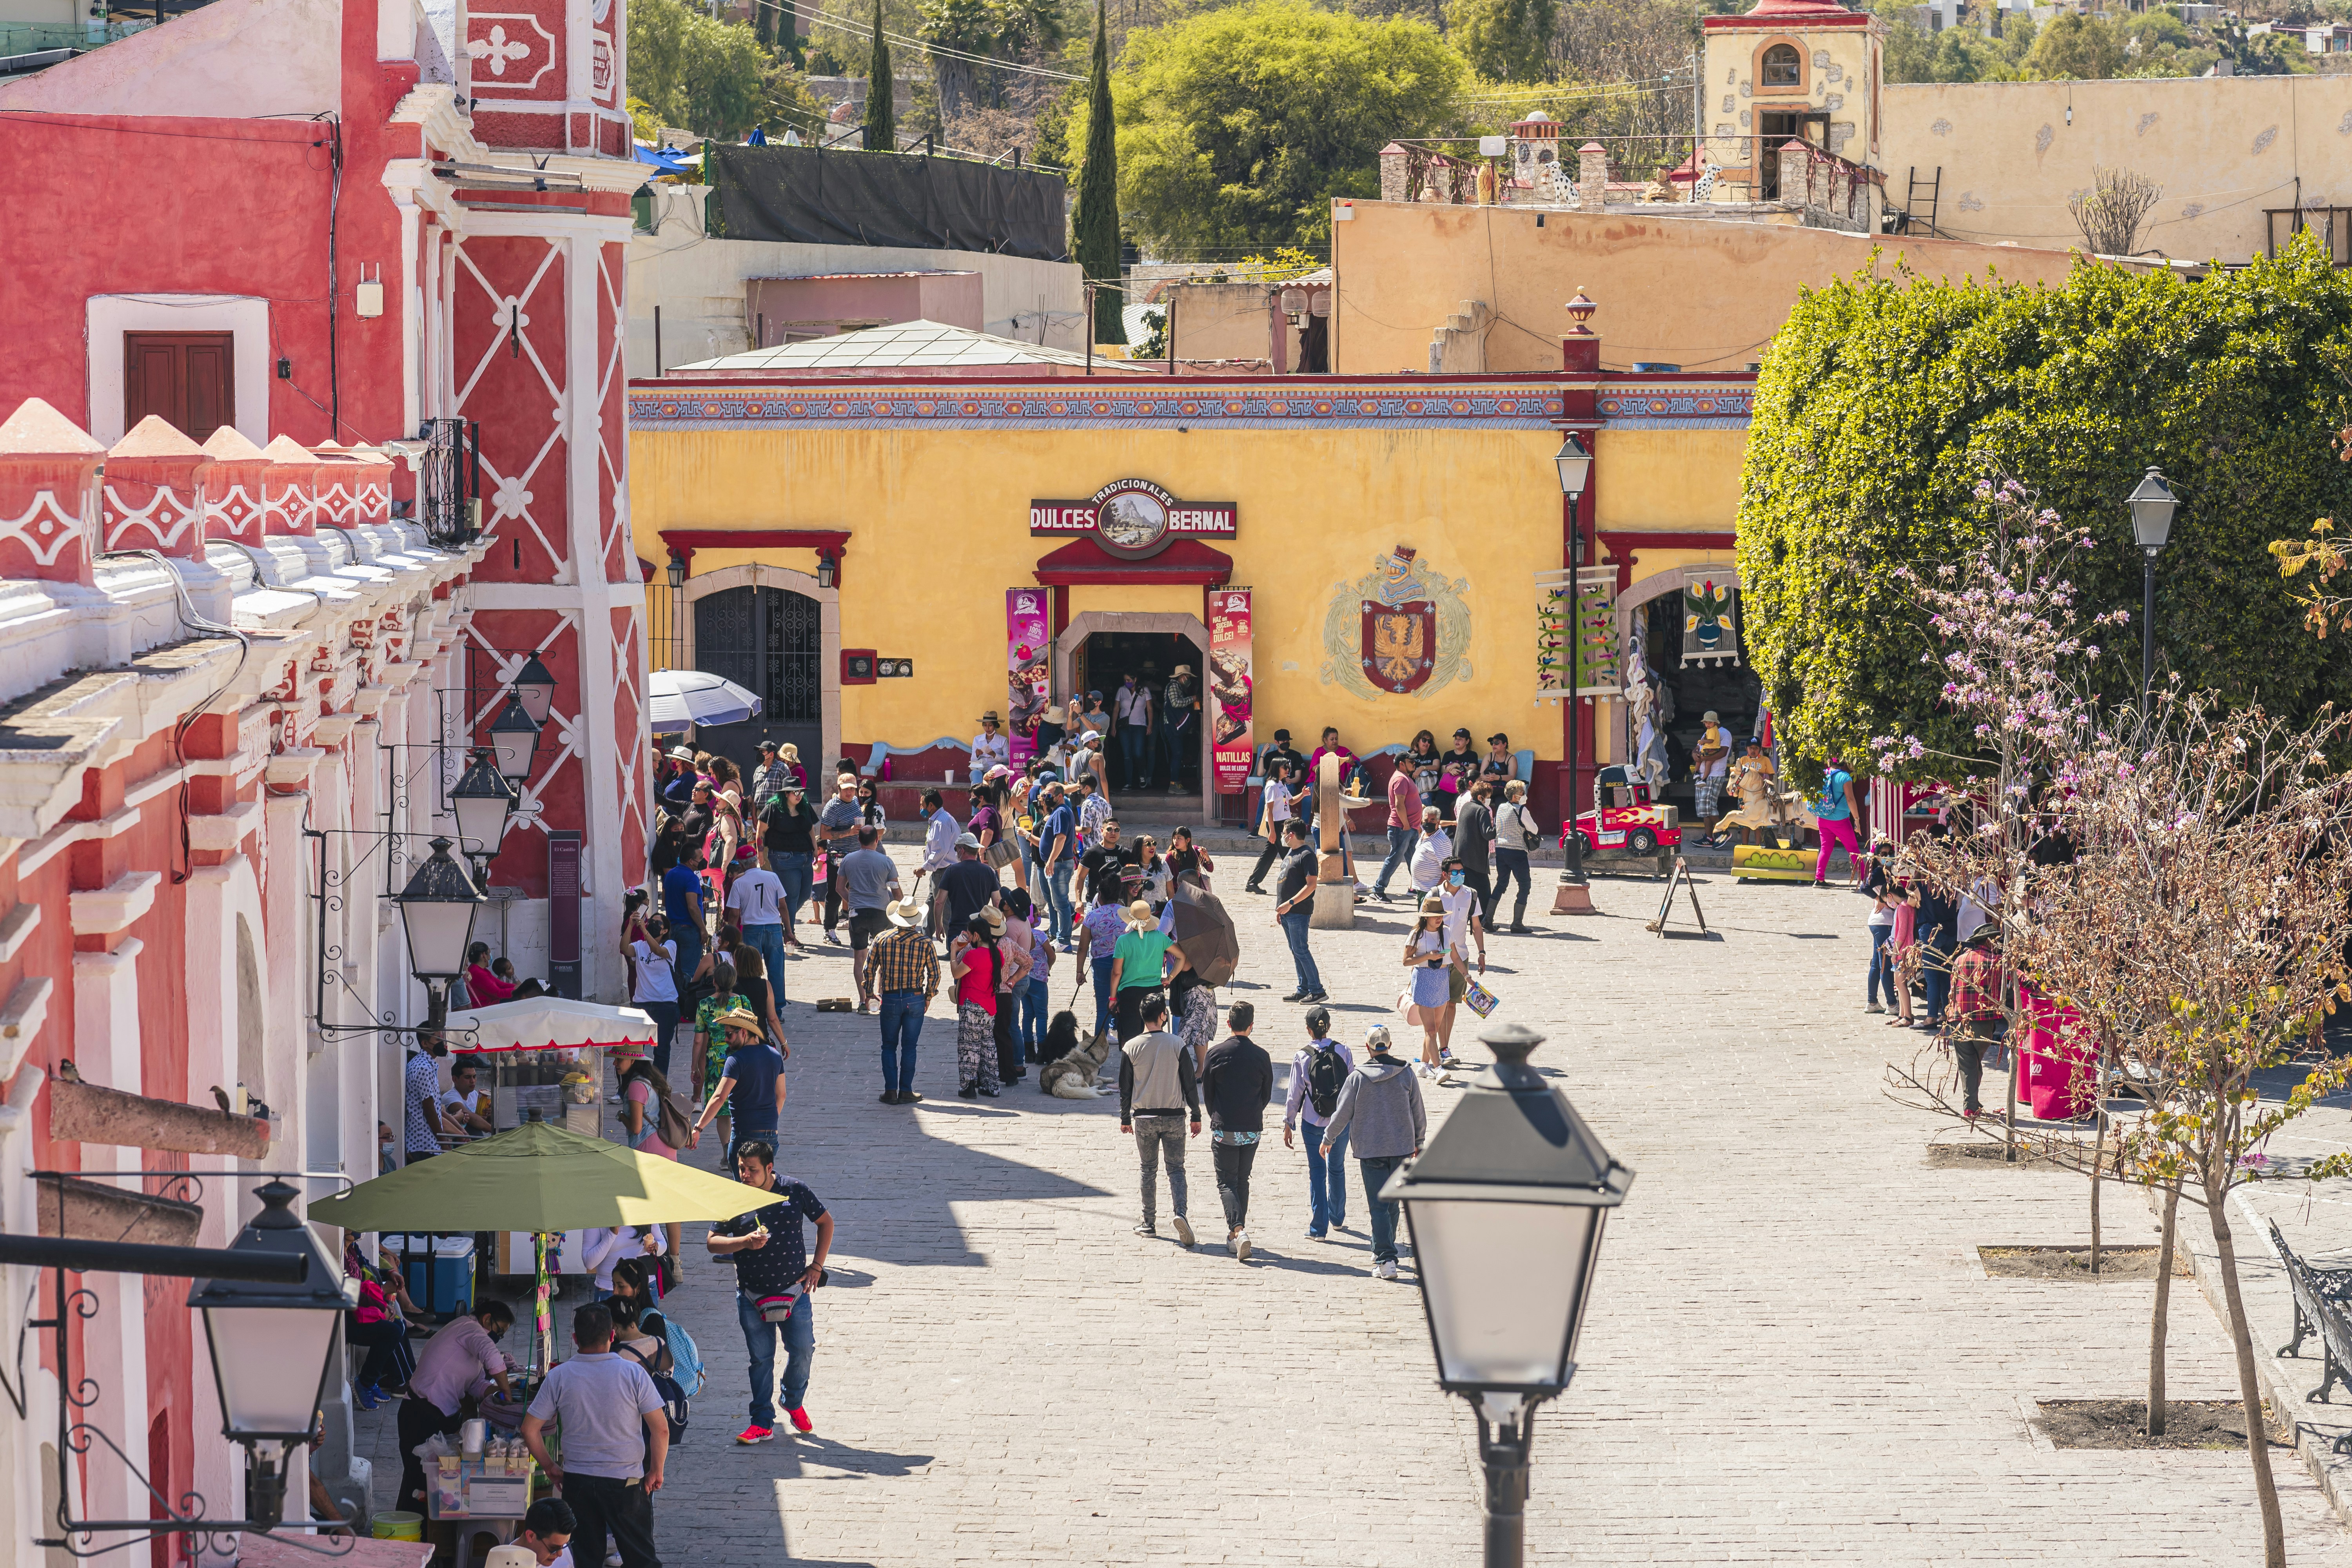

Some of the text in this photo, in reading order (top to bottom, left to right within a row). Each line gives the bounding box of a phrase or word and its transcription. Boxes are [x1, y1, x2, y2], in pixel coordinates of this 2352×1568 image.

[1092, 479, 1173, 506] TRADICIONALES
[1031, 508, 1234, 530] DULCES BERNAL
[1216, 620, 1234, 629] SUCEDA,
[1029, 626, 1042, 636] 100%
[1214, 631, 1234, 643] DULCE!
[1216, 752, 1250, 762] NATILLAS
[754, 883, 764, 909] 7
